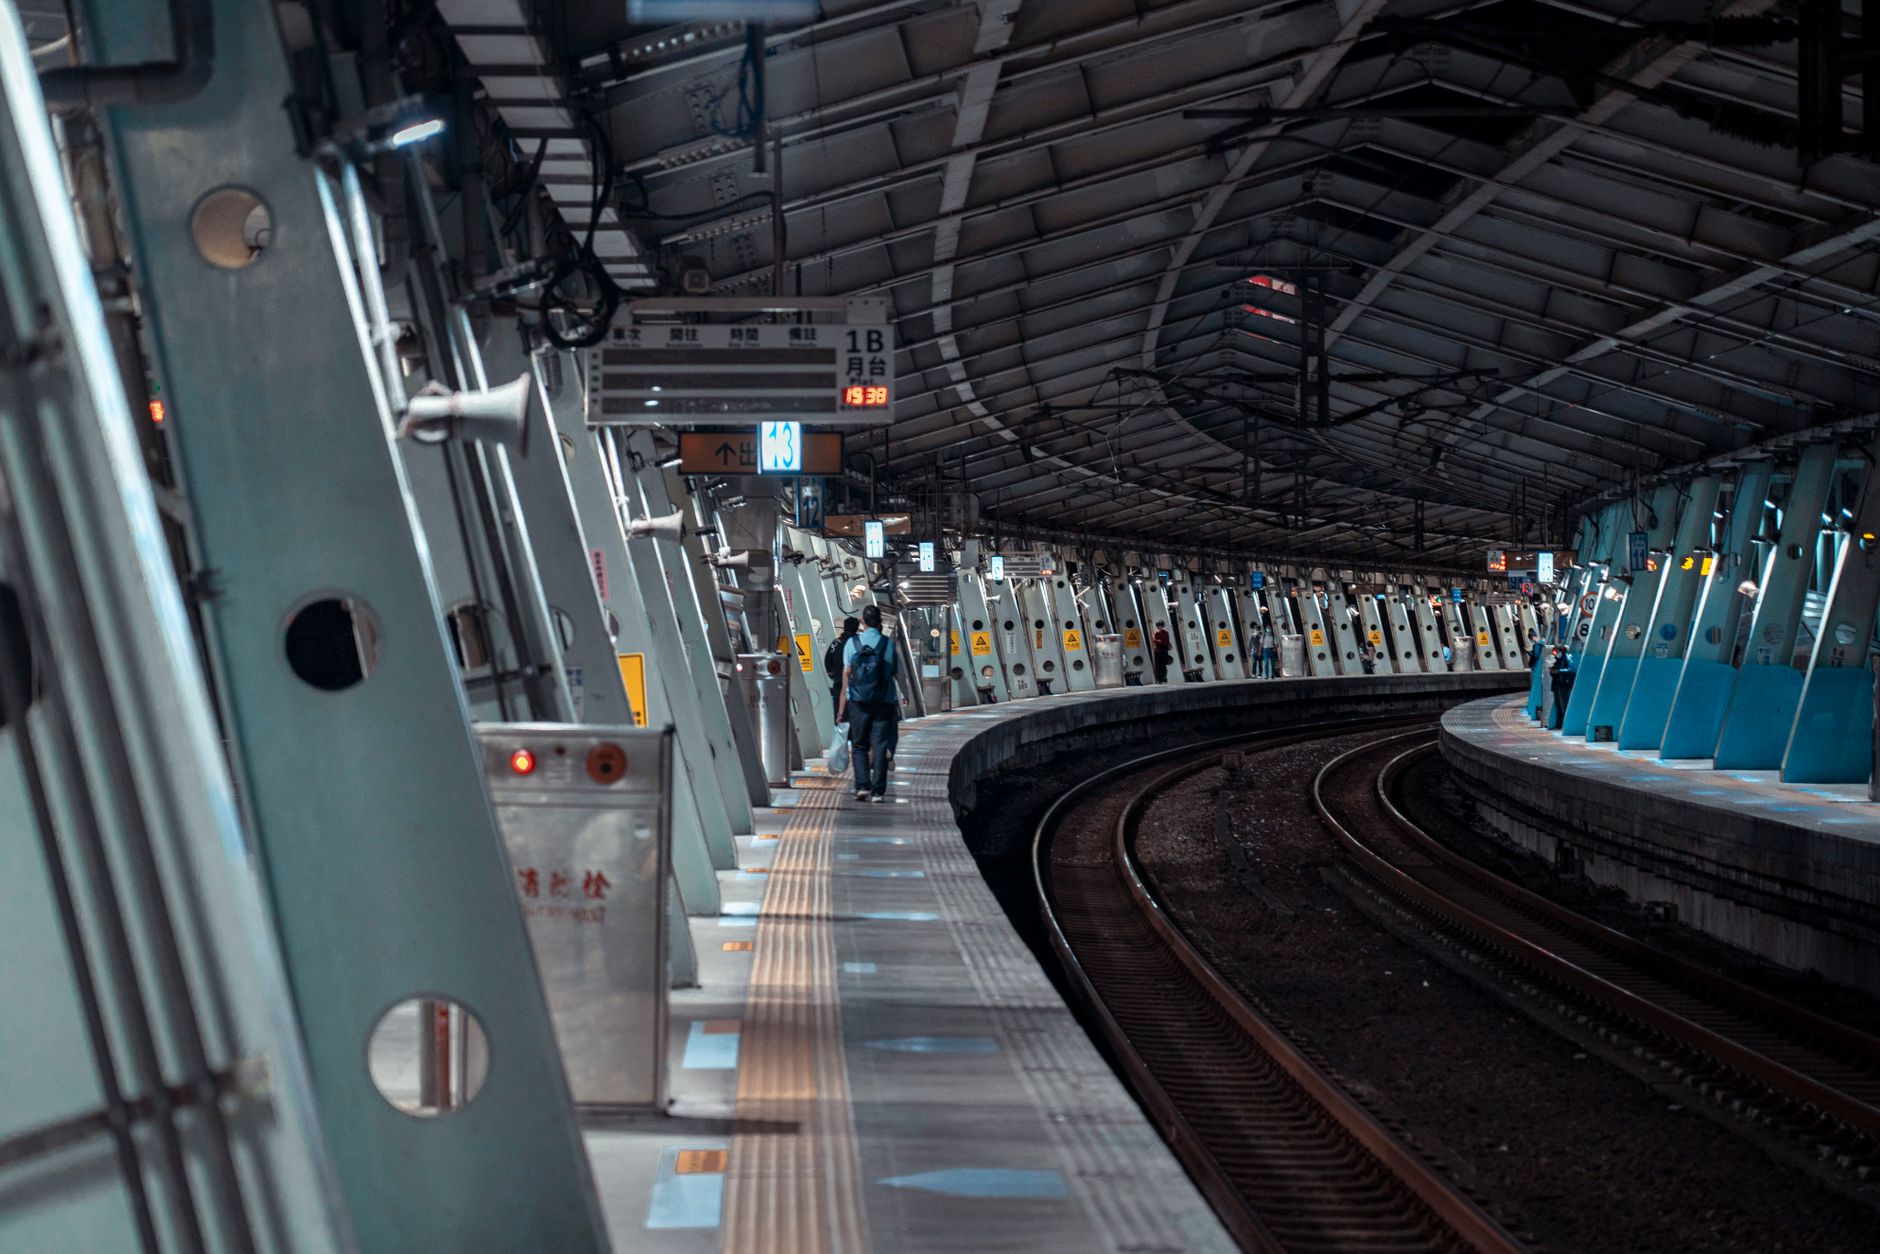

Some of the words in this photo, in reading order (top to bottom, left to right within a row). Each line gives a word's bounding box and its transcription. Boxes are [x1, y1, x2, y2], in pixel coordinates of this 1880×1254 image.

[846, 330, 884, 353] 1B
[847, 356, 887, 376] 月台
[768, 421, 794, 468] 13
[802, 496, 820, 527] 12
[1632, 548, 1646, 569] 11
[1584, 598, 1595, 611] 10
[1579, 623, 1590, 637] 8
